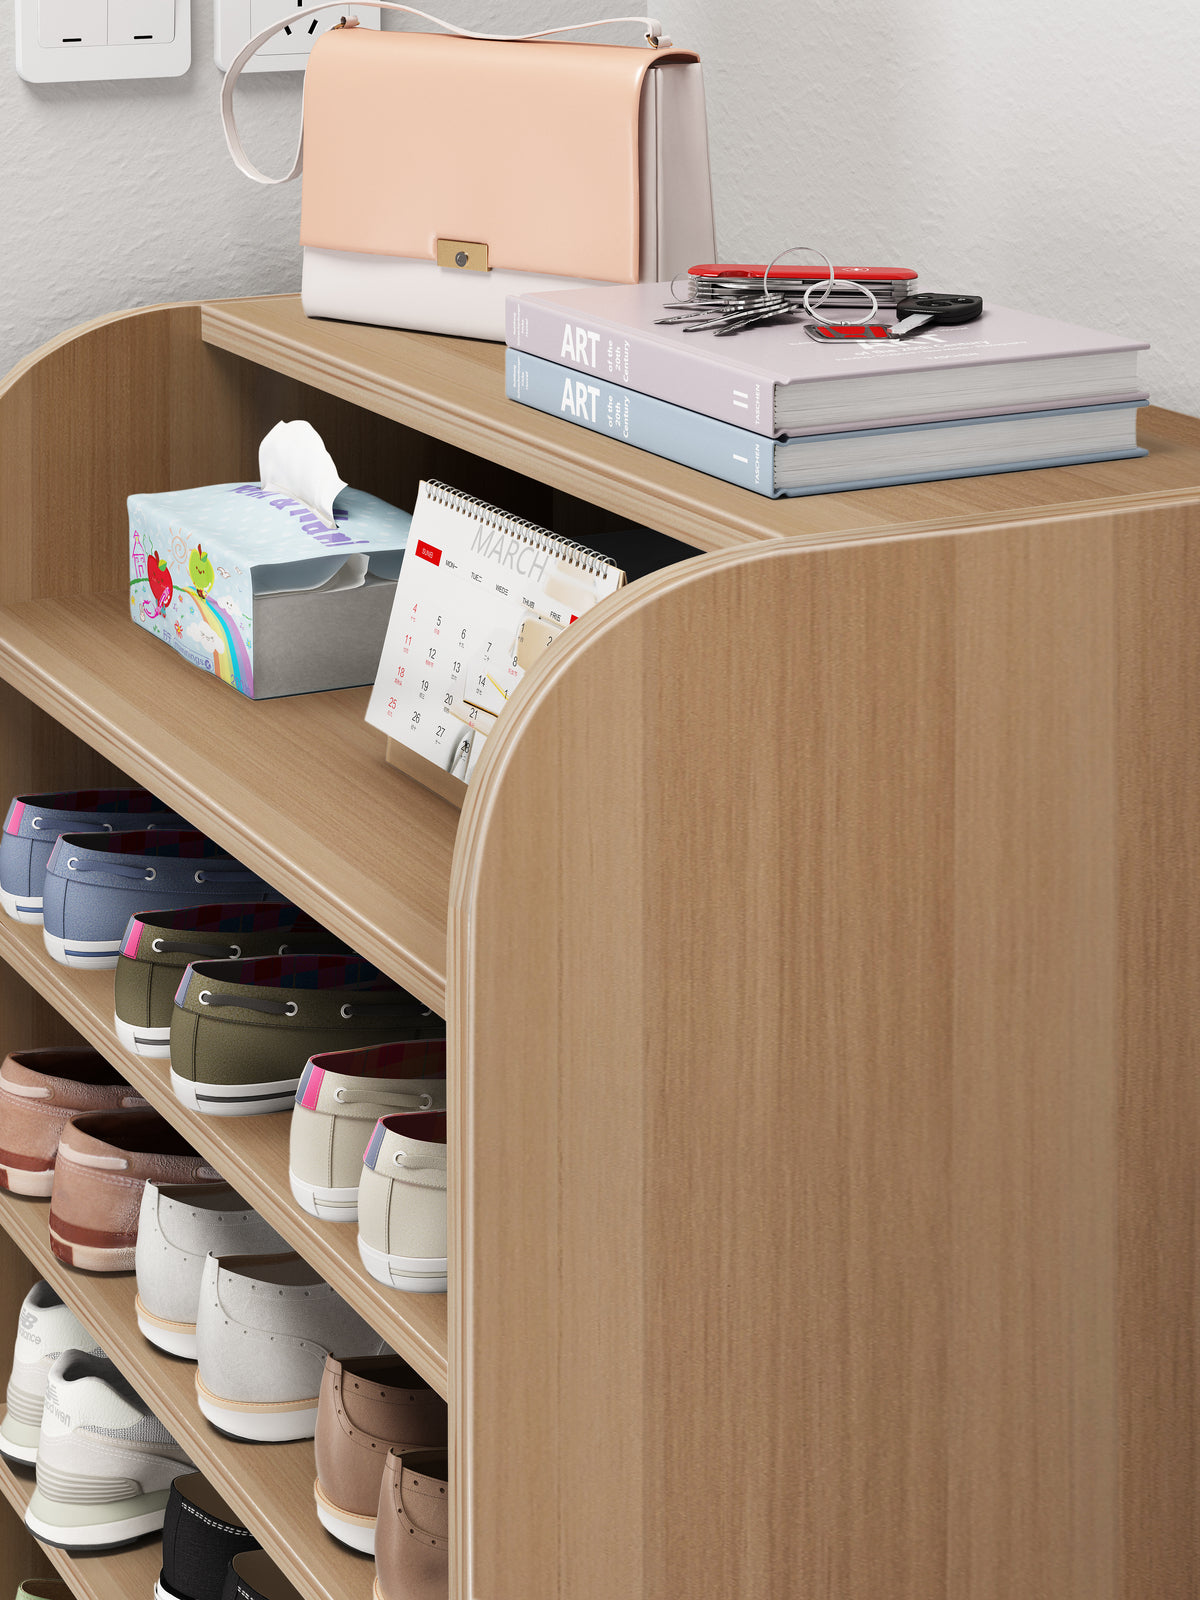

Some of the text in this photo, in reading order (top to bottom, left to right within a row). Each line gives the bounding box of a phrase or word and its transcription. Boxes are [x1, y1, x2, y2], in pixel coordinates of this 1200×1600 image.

[561, 323, 600, 369] ART
[607, 360, 613, 373] of
[561, 377, 600, 423] ART
[607, 414, 613, 428] of
[471, 525, 549, 583] MARCH
[412, 604, 518, 667] 4 5 6 7 8
[520, 623, 525, 633] 1
[405, 635, 412, 646] 11
[429, 648, 436, 660] 12
[453, 661, 461, 673] 13
[478, 675, 486, 687] 14
[398, 666, 478, 720] 18 19 20 21
[388, 697, 471, 753] 25 26 27 28
